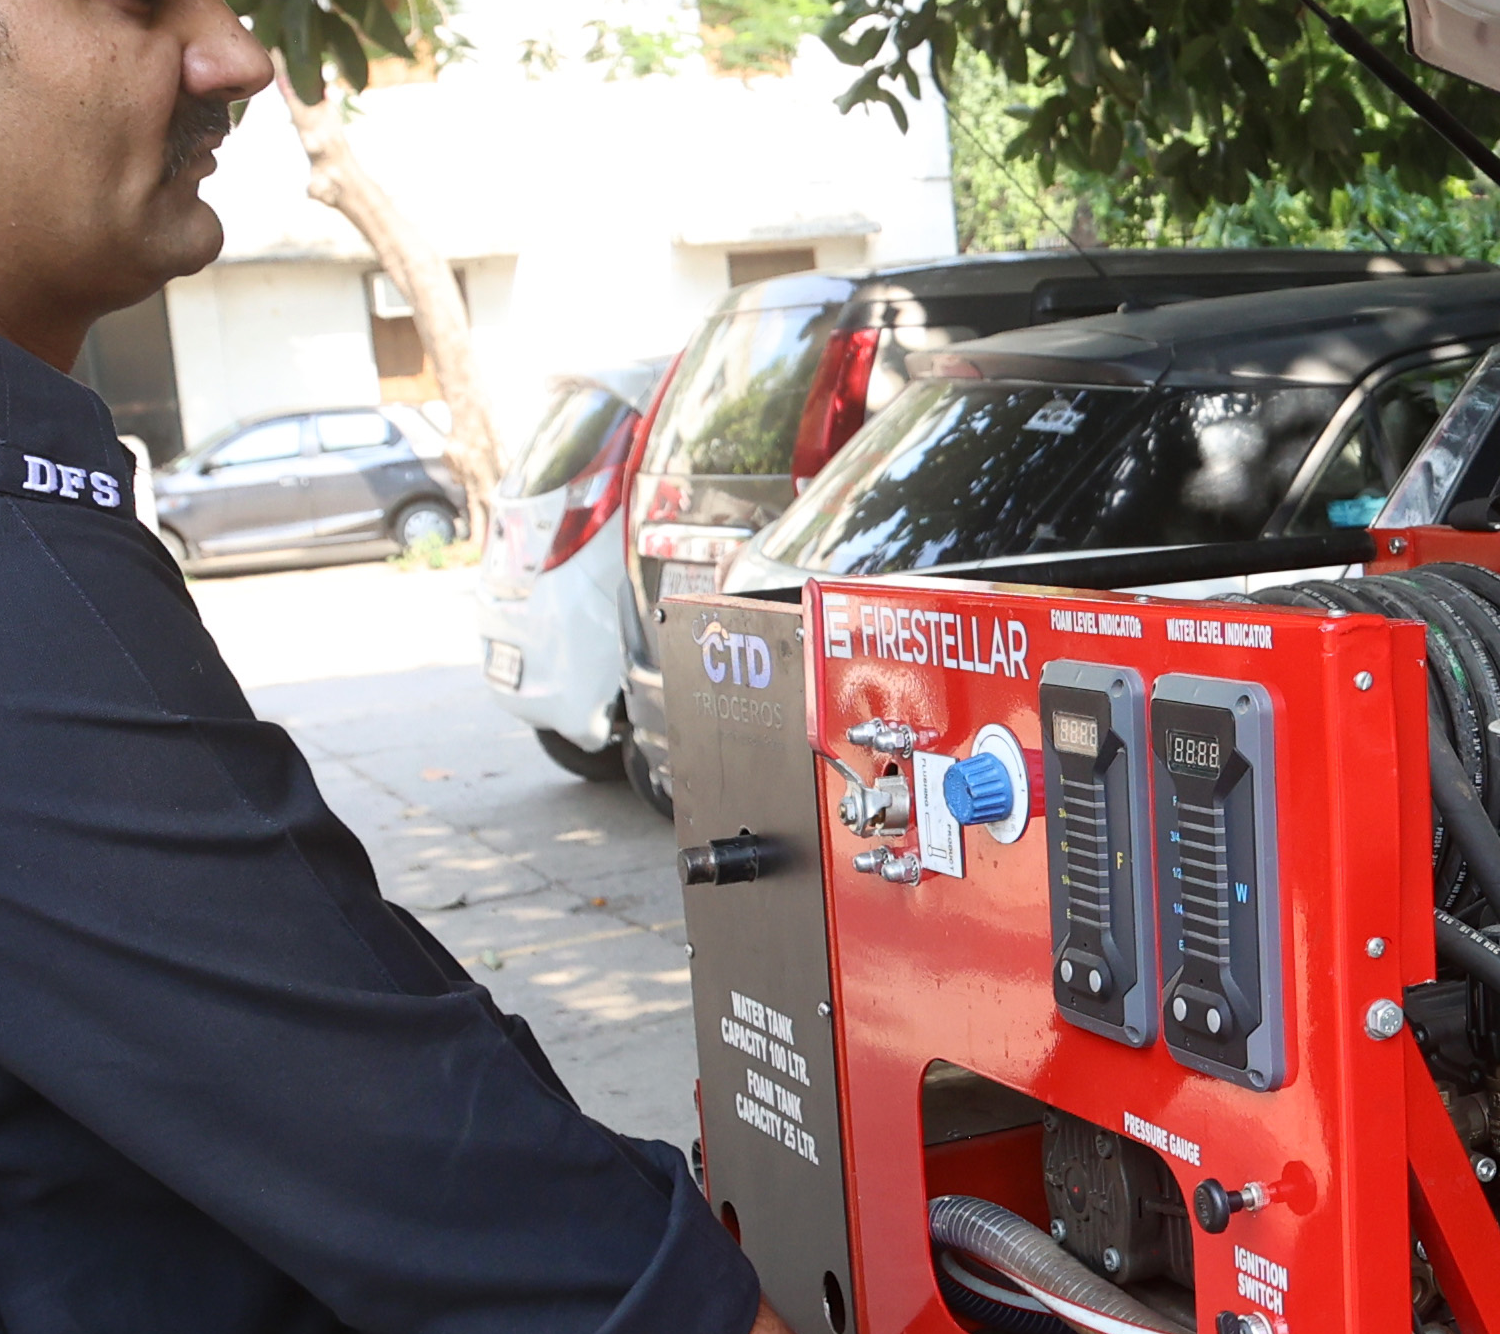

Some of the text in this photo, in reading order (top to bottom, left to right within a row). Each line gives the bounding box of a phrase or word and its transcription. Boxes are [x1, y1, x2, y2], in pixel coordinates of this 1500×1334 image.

[22, 454, 121, 508] DFS
[860, 604, 1030, 680] FIRESTELLAR
[1050, 609, 1143, 639] FOAM LEVEL INDICATOR
[1166, 618, 1273, 650] WATER LEVEL INDICATOR
[701, 632, 773, 690] CTD
[692, 691, 783, 730] TRIOCEROS
[1235, 881, 1249, 904] W
[730, 990, 795, 1046] WATER TANK
[721, 1016, 811, 1087] CAPACITY 100 LTR.
[747, 1068, 803, 1124] FOAM TANK
[735, 1092, 819, 1166] CAPACITY 25 LTR.
[1123, 1111, 1200, 1166] PRESSURE GAUGE
[1234, 1245, 1288, 1292] IGNITION
[1238, 1272, 1284, 1315] SWITCH
